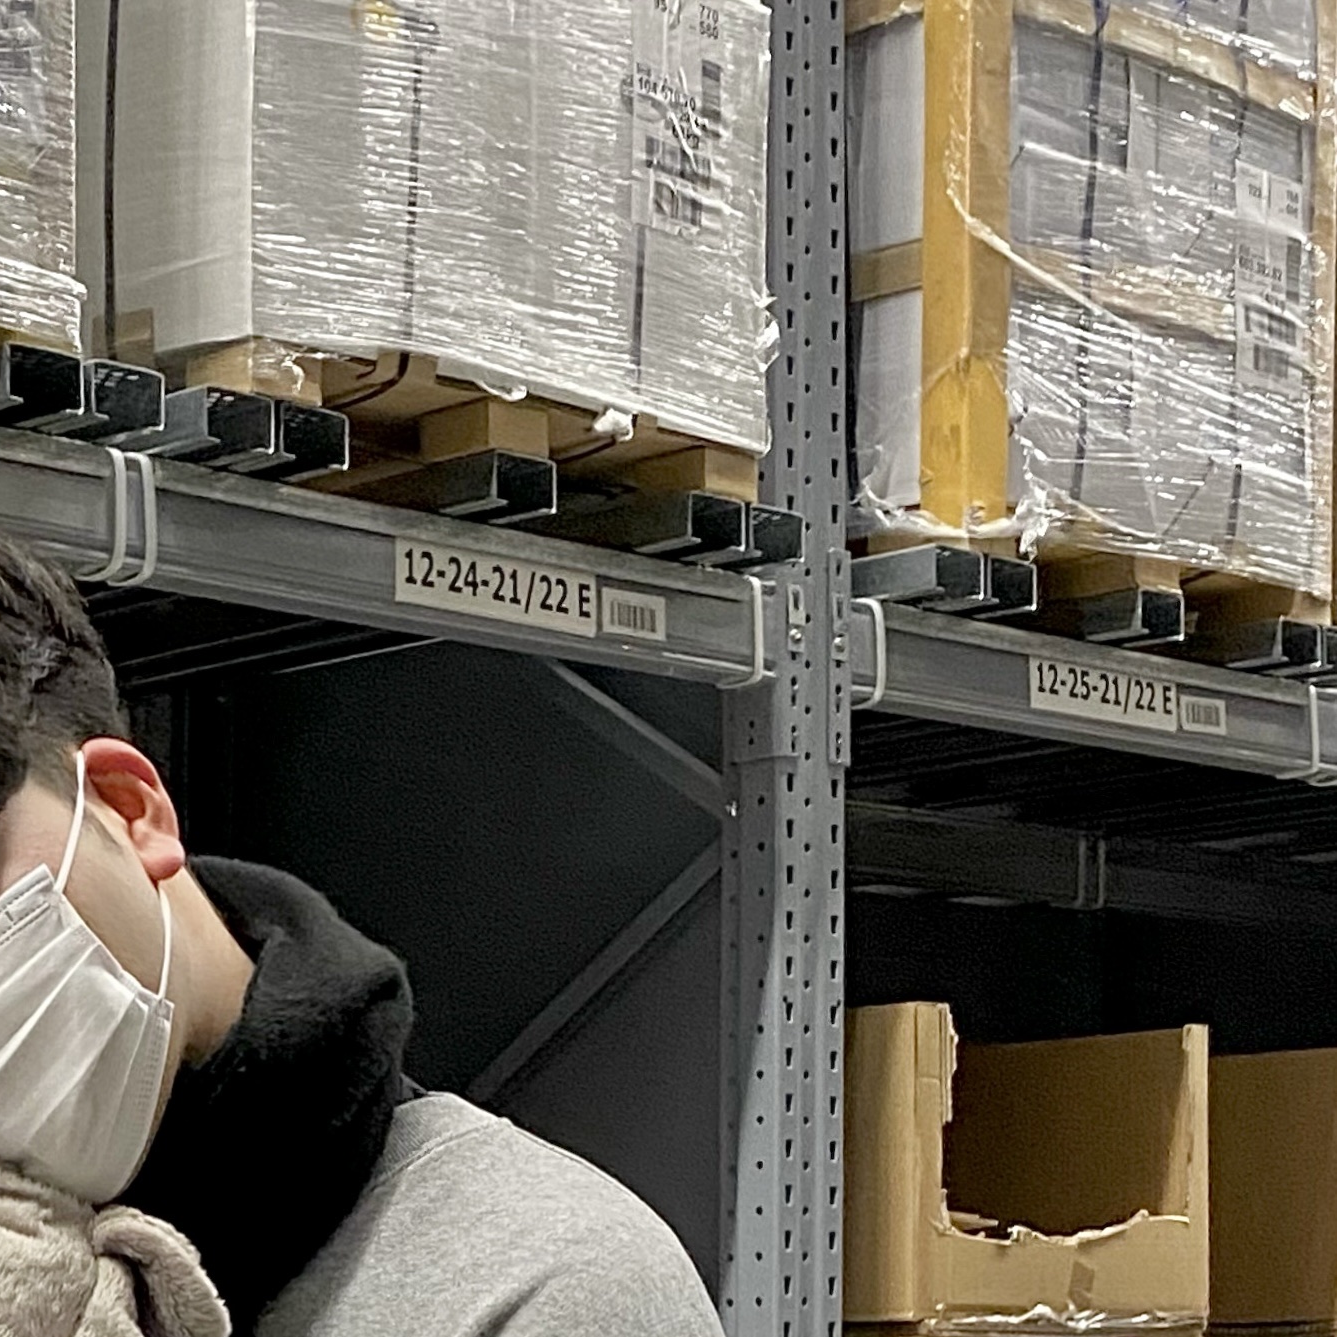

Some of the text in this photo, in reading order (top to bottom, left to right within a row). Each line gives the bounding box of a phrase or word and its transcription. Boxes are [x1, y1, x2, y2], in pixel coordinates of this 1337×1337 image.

[404, 548, 591, 618] 12-24-21/22 E
[1036, 662, 1173, 715] 12-25-21/22 E
